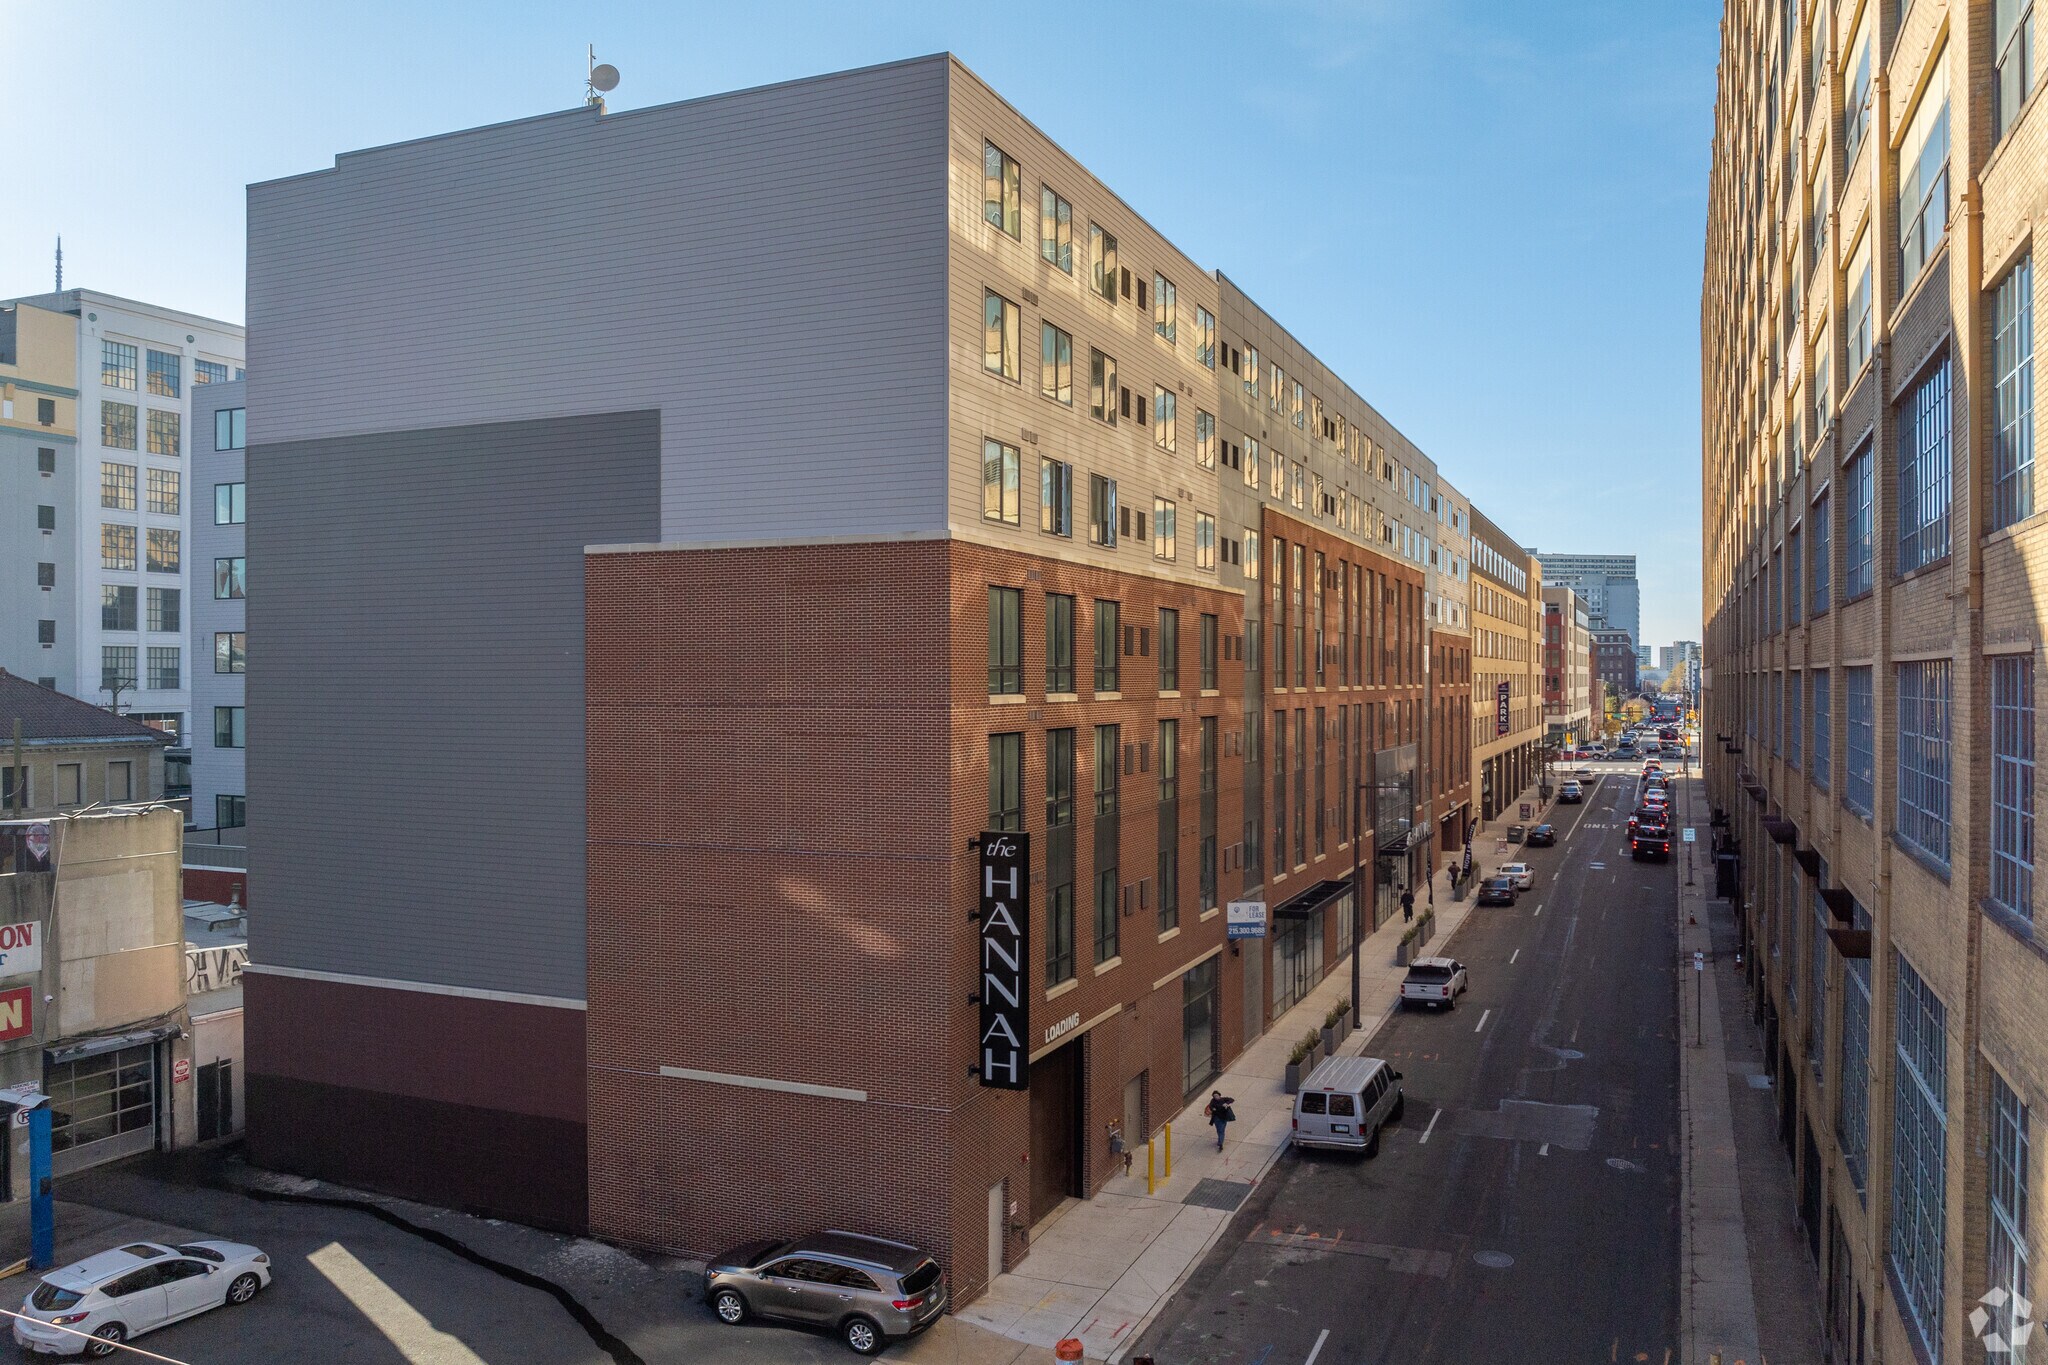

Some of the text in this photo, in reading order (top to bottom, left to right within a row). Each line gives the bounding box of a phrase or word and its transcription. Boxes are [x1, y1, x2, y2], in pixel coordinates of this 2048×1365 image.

[1500, 695, 1508, 722] PARK
[986, 837, 1016, 857] the
[982, 865, 1021, 1083] HANNAH
[1045, 1012, 1080, 1044] LOADING
